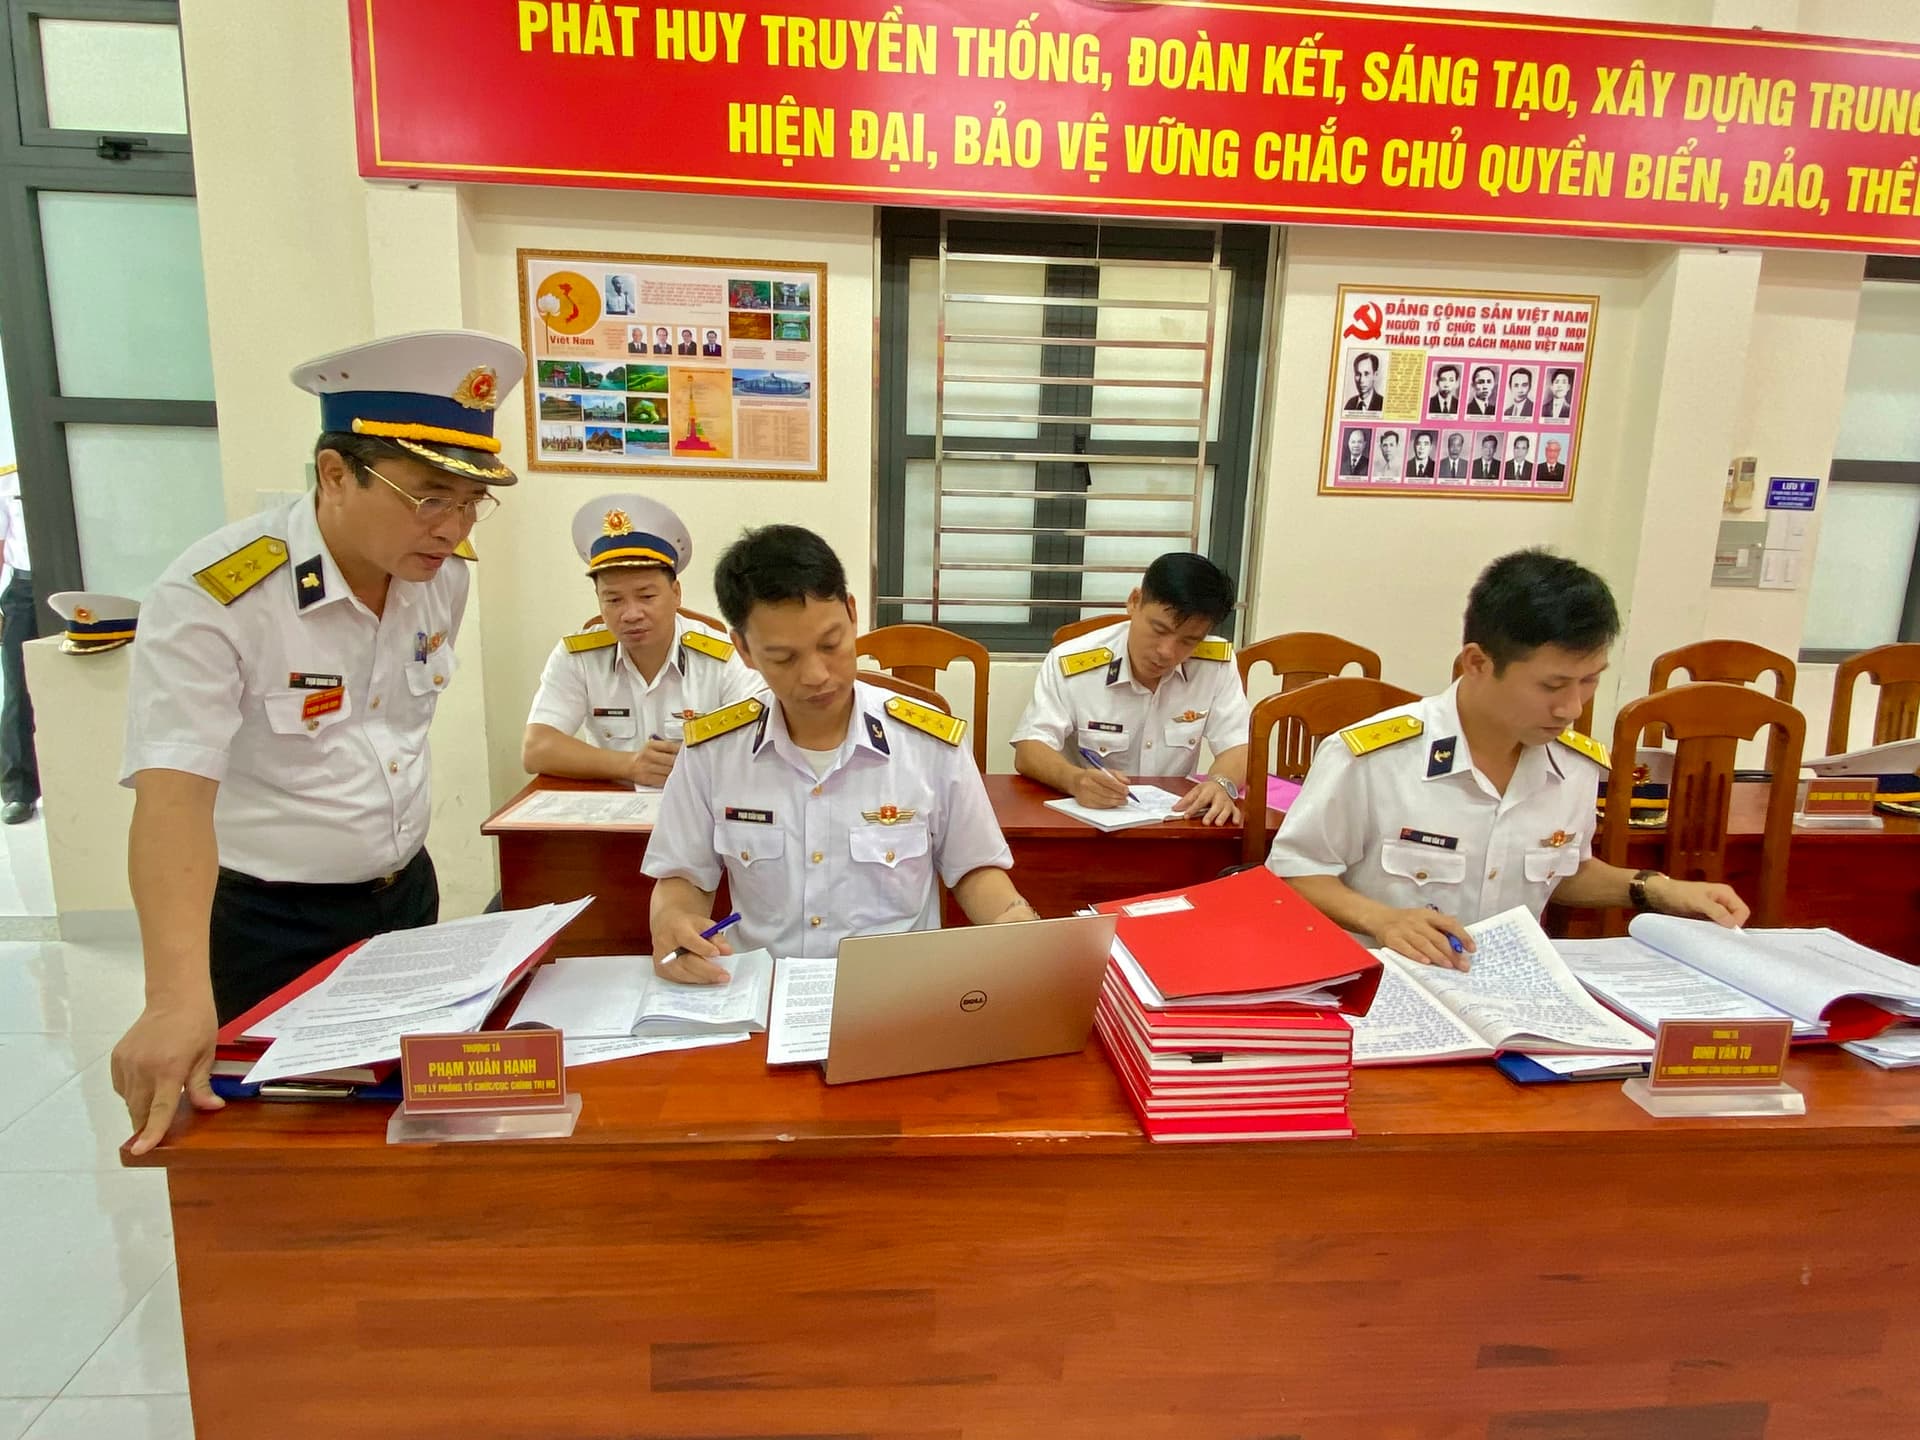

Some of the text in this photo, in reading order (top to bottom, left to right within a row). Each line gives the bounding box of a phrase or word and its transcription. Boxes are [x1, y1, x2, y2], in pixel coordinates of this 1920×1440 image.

[518, 0, 640, 57] PHÁT
[655, 8, 747, 64] HUY
[760, 4, 937, 75] TRUYỀN
[953, 17, 1112, 91] THỐNG,
[1127, 30, 1250, 93] ĐOÀN
[1262, 32, 1346, 105] KẾT,
[1361, 43, 1479, 106] SÁNG
[1493, 60, 1578, 121] TẠO,
[1590, 60, 1676, 118] XÂY
[1683, 73, 1797, 134] DỰNG
[728, 95, 1920, 217] HIỆN ĐẠI, BẢO VỆ VỮNG CHẮC CHỦ QUYỀN BIỂN, ĐẢO, THỀ
[1385, 298, 1589, 323] ĐẢNG CỘNG SẢN VIỆT NAM
[572, 336, 595, 345] Nam
[1386, 318, 1586, 340] NGƯỜI TỔ CHỨC VÀ LÃNH ĐẠO MỌI
[1385, 332, 1585, 353] THẮNG LỢI CỦA CÁCH MẠNG VIỆT NAM
[428, 1057, 537, 1080] PHẠM XUÂN HẠNH
